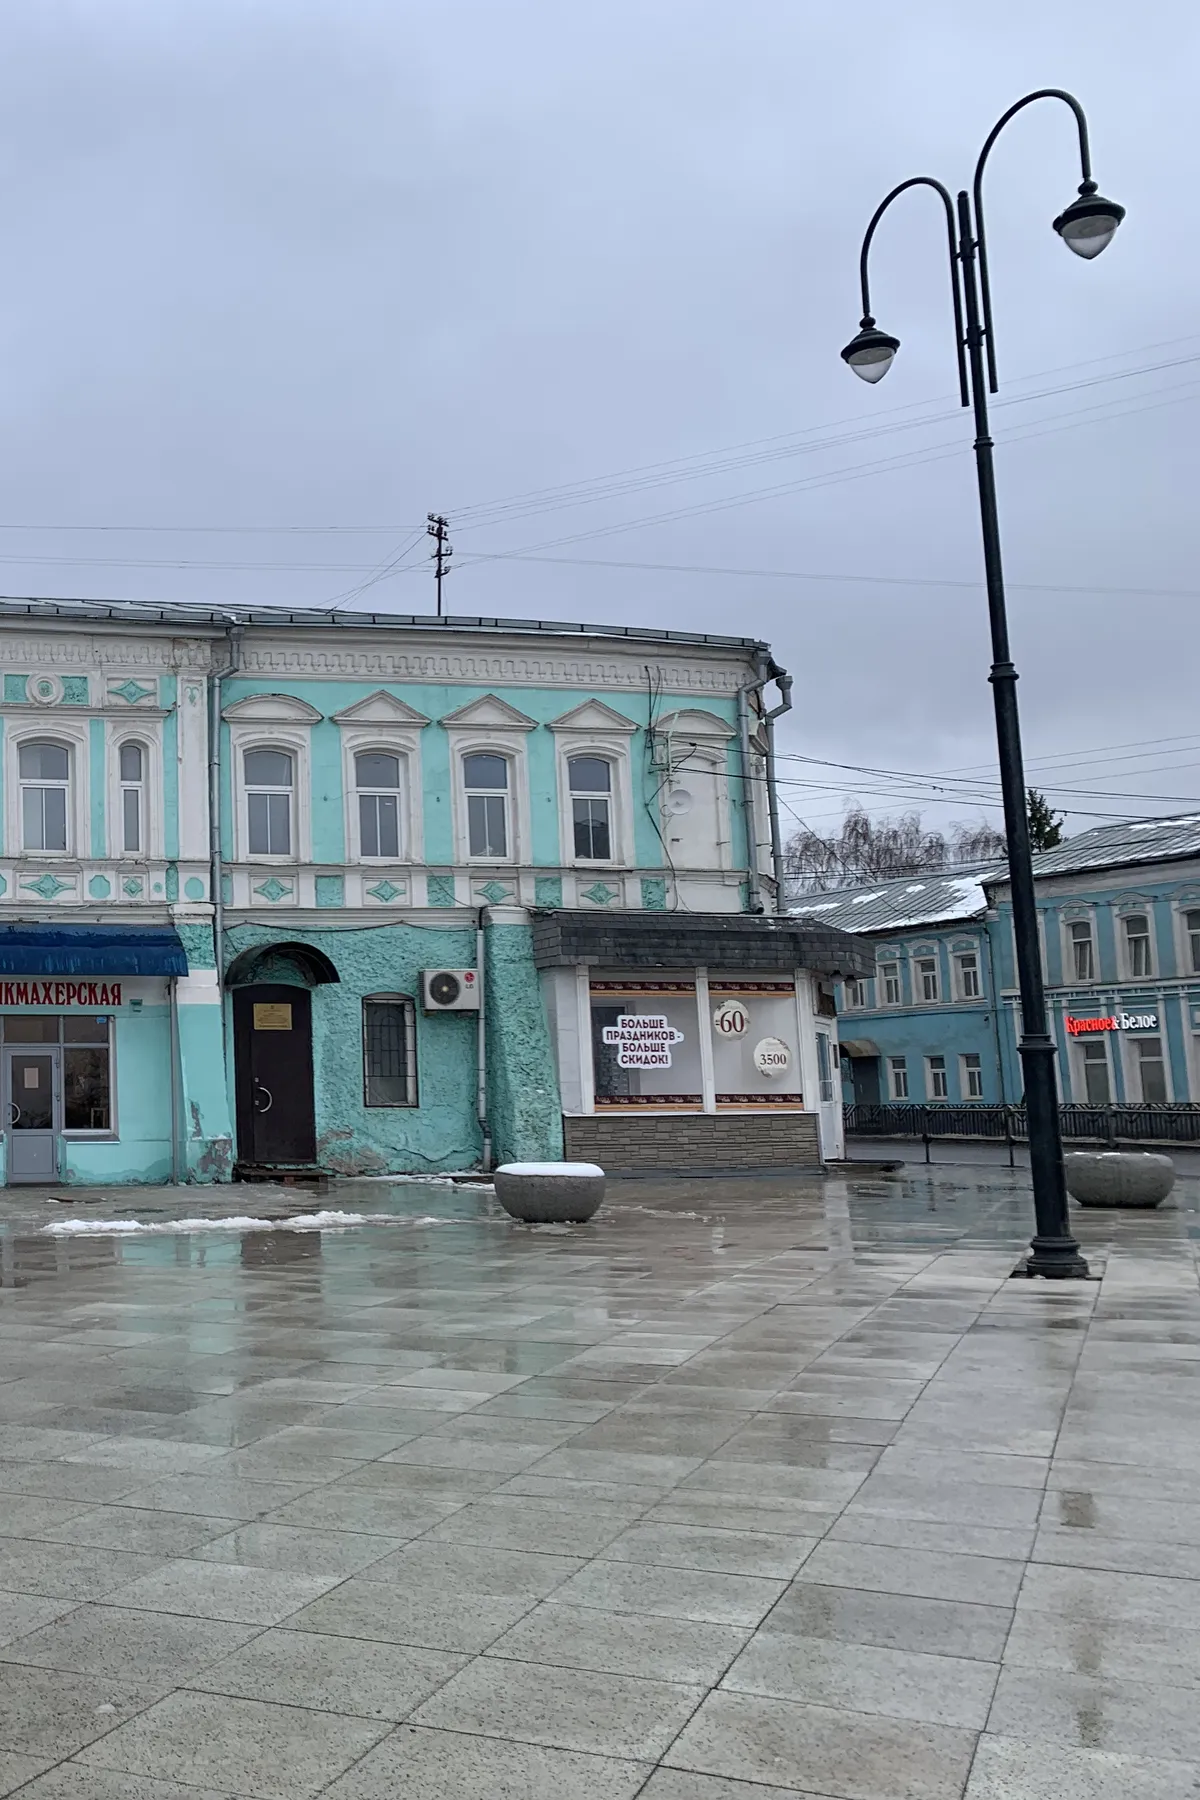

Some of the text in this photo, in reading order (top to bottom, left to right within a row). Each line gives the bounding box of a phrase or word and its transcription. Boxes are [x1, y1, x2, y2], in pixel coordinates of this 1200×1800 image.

[621, 1019, 664, 1028] БОЛЬШЕ
[606, 1030, 675, 1041] ПРАЗДНИКОВ
[622, 1043, 666, 1052] БОЛЬШЕ
[621, 1054, 668, 1065] СКИДОК!
[760, 1054, 786, 1065] 3500
